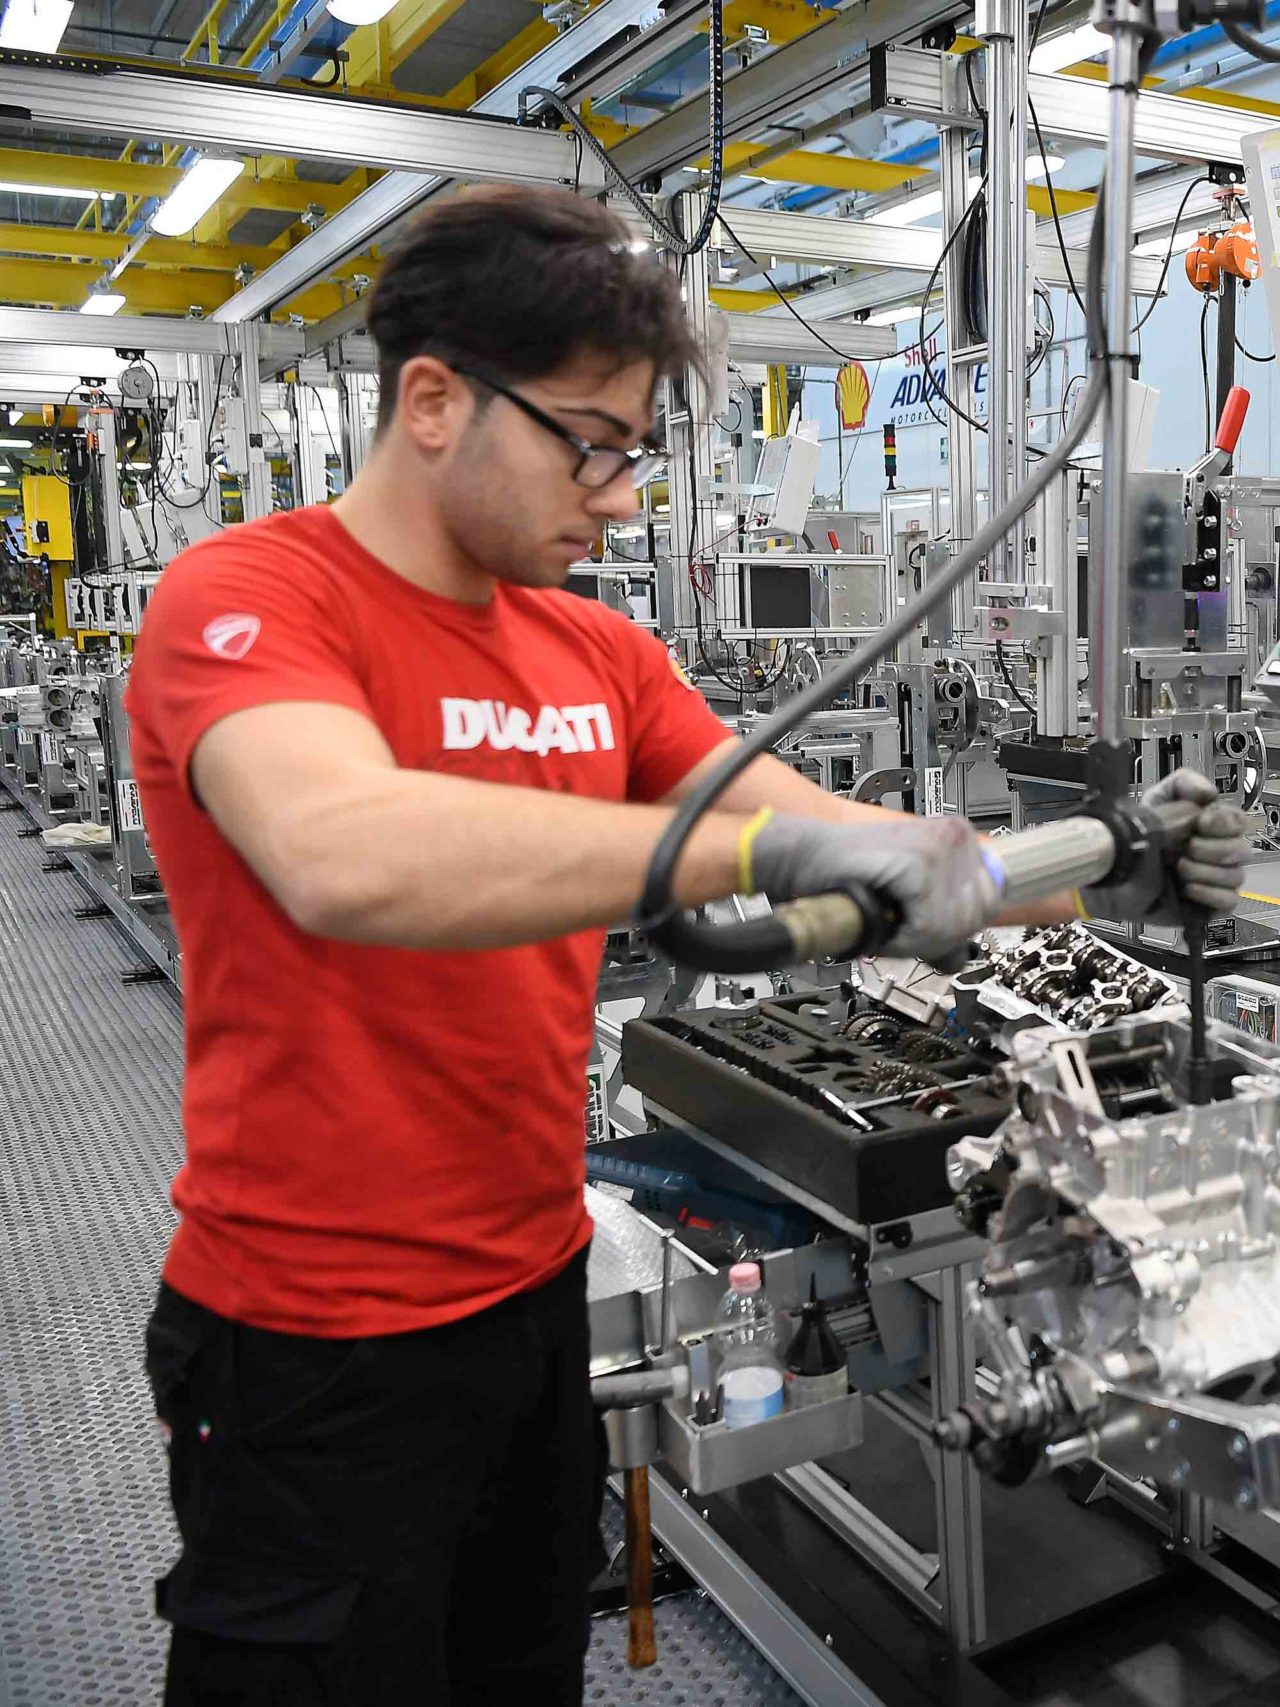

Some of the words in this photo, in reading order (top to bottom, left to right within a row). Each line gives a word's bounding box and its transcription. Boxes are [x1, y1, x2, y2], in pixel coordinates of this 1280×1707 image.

[904, 338, 937, 368] Shell
[890, 362, 988, 408] ADVAE
[440, 697, 616, 757] DUCATI
